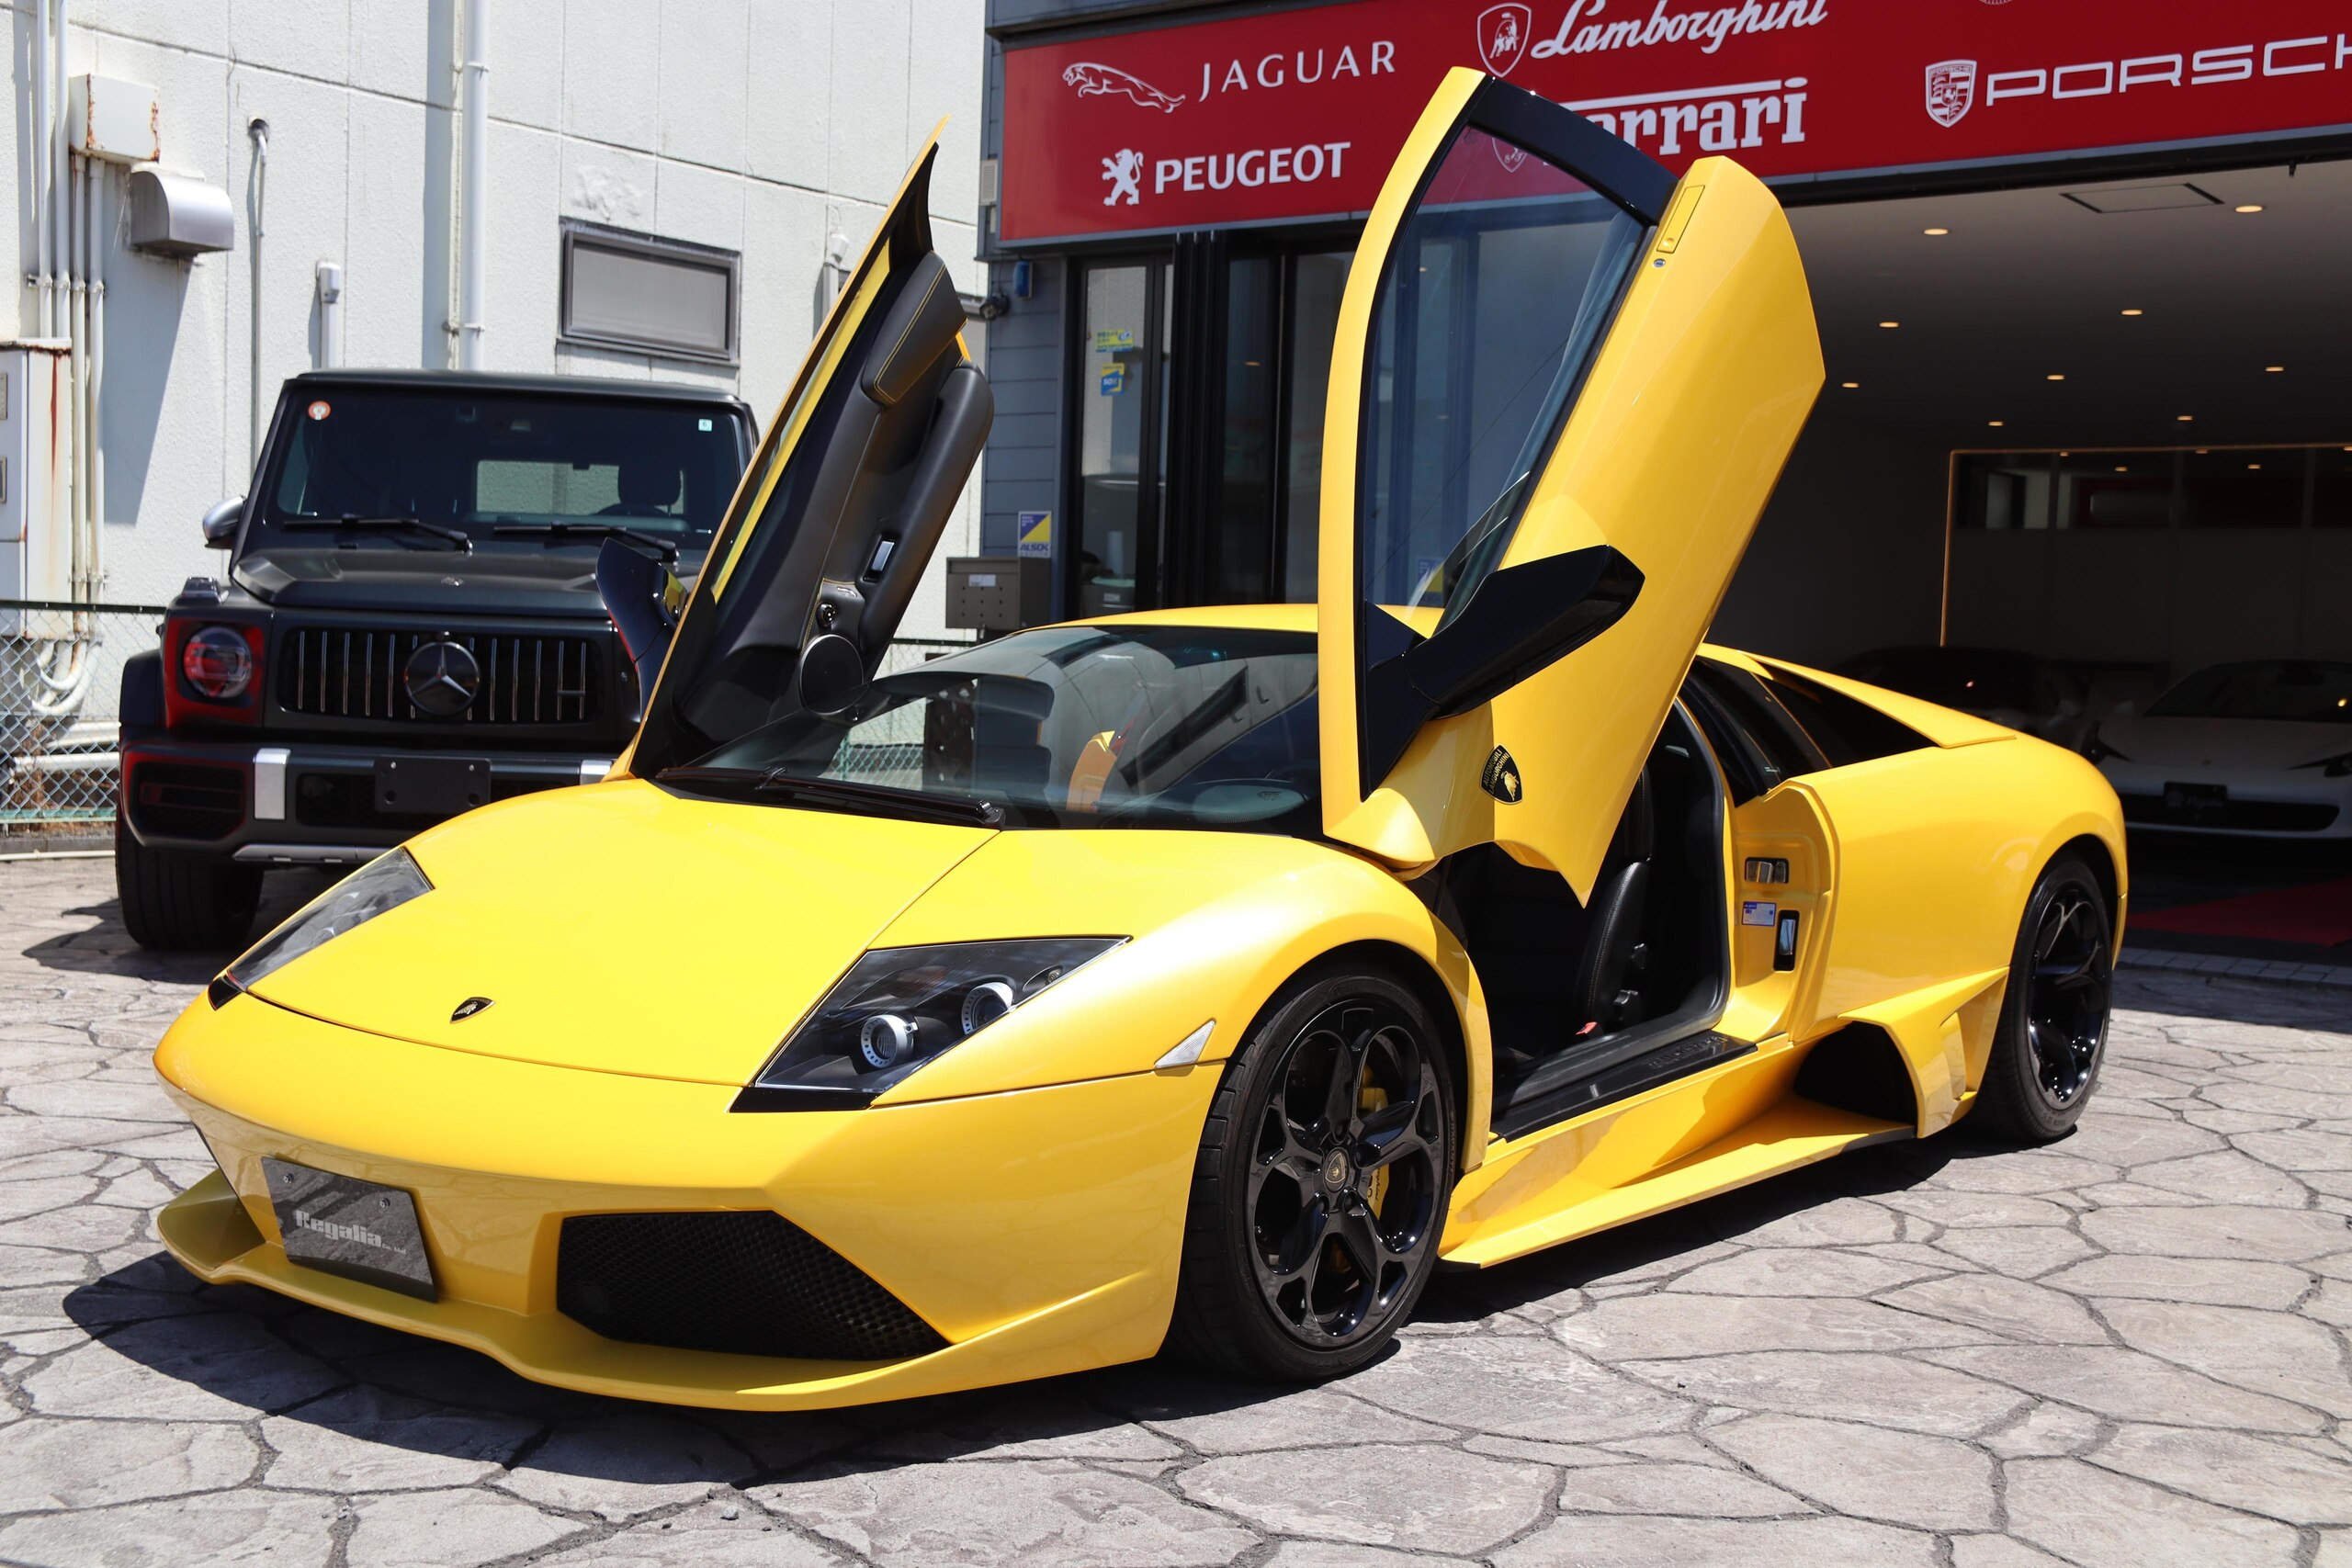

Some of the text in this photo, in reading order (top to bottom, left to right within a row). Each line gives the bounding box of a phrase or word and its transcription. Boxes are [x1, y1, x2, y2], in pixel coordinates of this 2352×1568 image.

[1530, 0, 1829, 60] Lamborghini
[1198, 40, 1396, 103] JAGUAR
[1985, 33, 2352, 107] PORSC
[1154, 141, 1351, 194] PEUGEOT
[1488, 751, 1510, 795] LAMBORGHINI
[295, 1209, 383, 1248] Regalia
